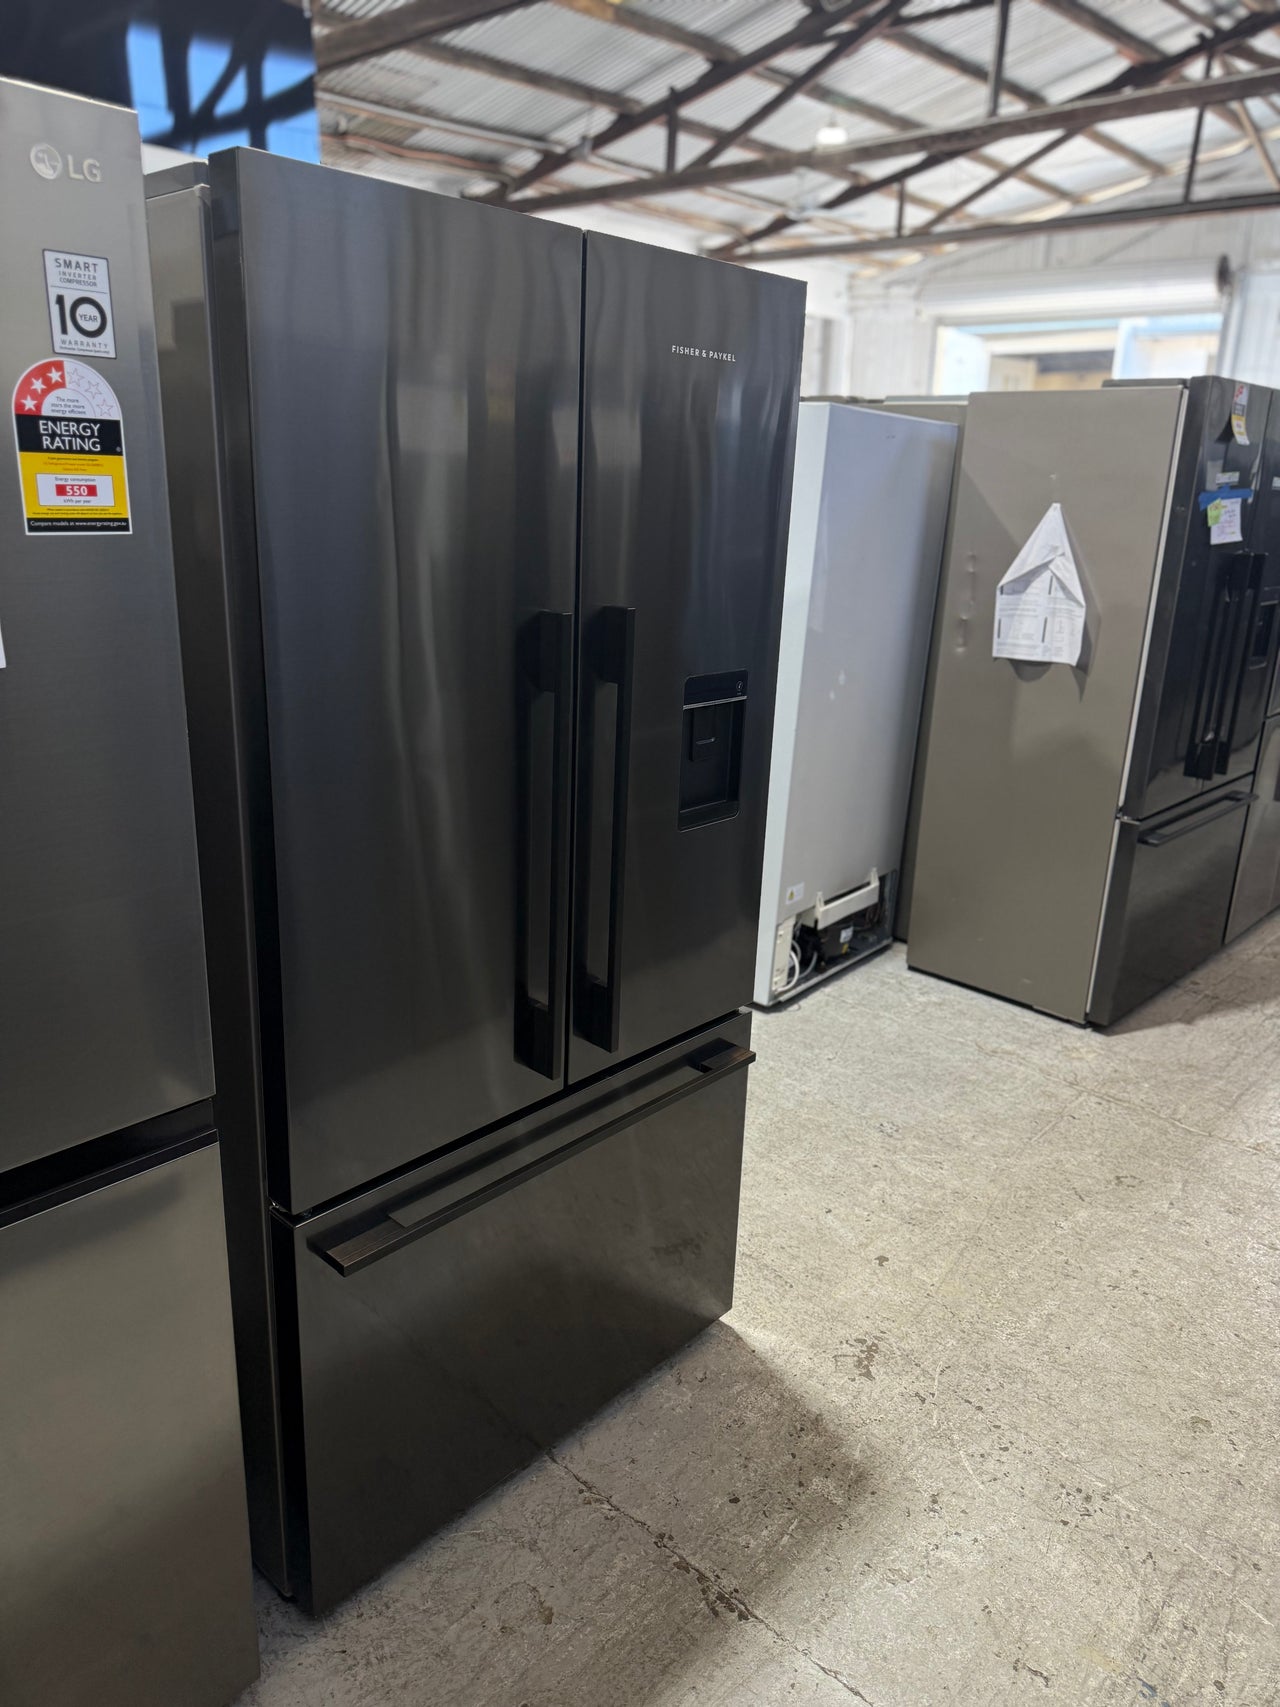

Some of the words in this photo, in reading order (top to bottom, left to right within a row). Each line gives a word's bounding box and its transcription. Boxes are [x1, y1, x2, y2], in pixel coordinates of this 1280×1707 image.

[67, 154, 102, 183] LG
[55, 258, 98, 273] SMART
[58, 270, 97, 281] INVERTER
[59, 277, 98, 288] COMPRESSOR
[55, 294, 107, 338] 10
[79, 313, 98, 322] YEAR
[60, 339, 109, 349] WARRANTY
[671, 345, 700, 357] FISHER
[701, 349, 707, 358] &
[709, 351, 736, 362] PAYKEL
[39, 420, 101, 436] ENERGY
[42, 436, 101, 452] RATING
[66, 485, 88, 496] 550
